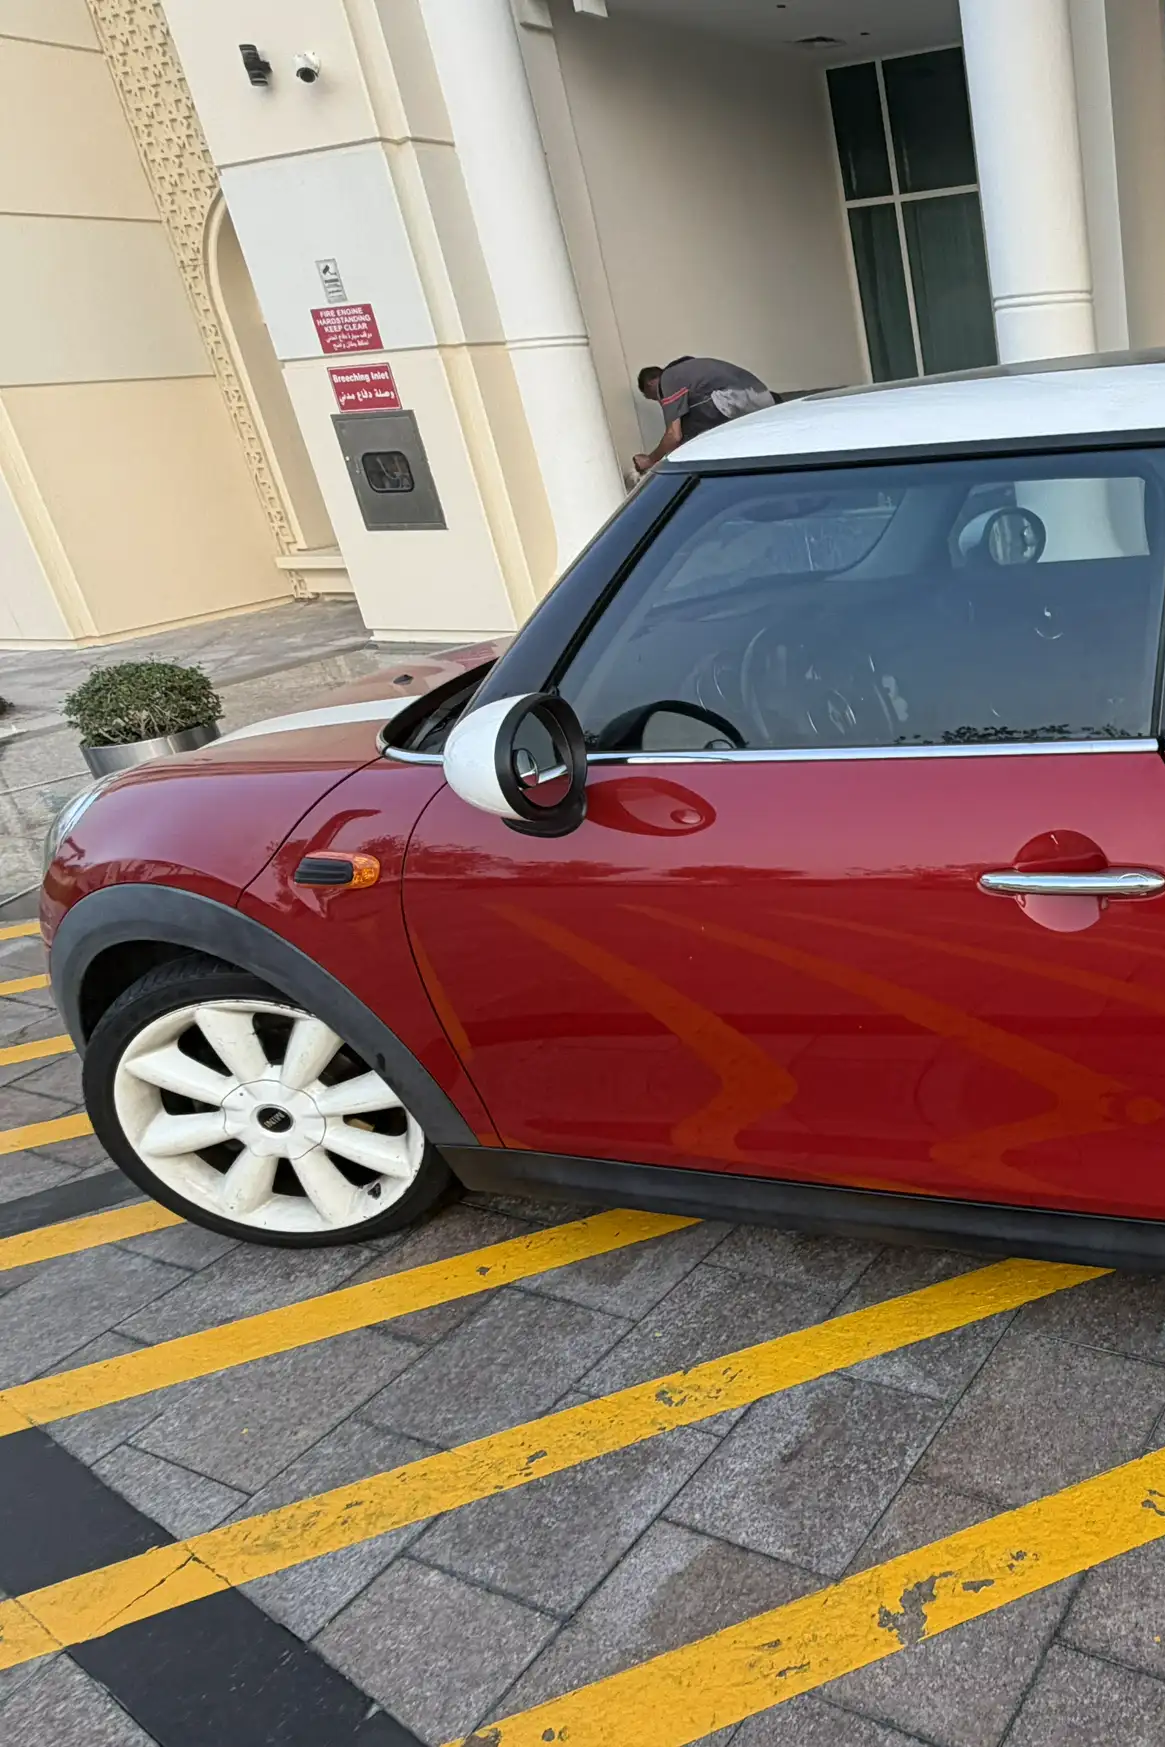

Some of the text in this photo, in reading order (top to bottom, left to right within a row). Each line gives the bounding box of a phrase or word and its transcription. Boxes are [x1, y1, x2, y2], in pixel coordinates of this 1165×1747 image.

[319, 307, 363, 318] FIRE ENGINE
[316, 314, 371, 326] HARDSTANDING
[324, 322, 368, 333] KEEP CLEAR
[332, 371, 389, 383] Breeching Inlet
[339, 388, 395, 405] وصلة دفاع مدني
